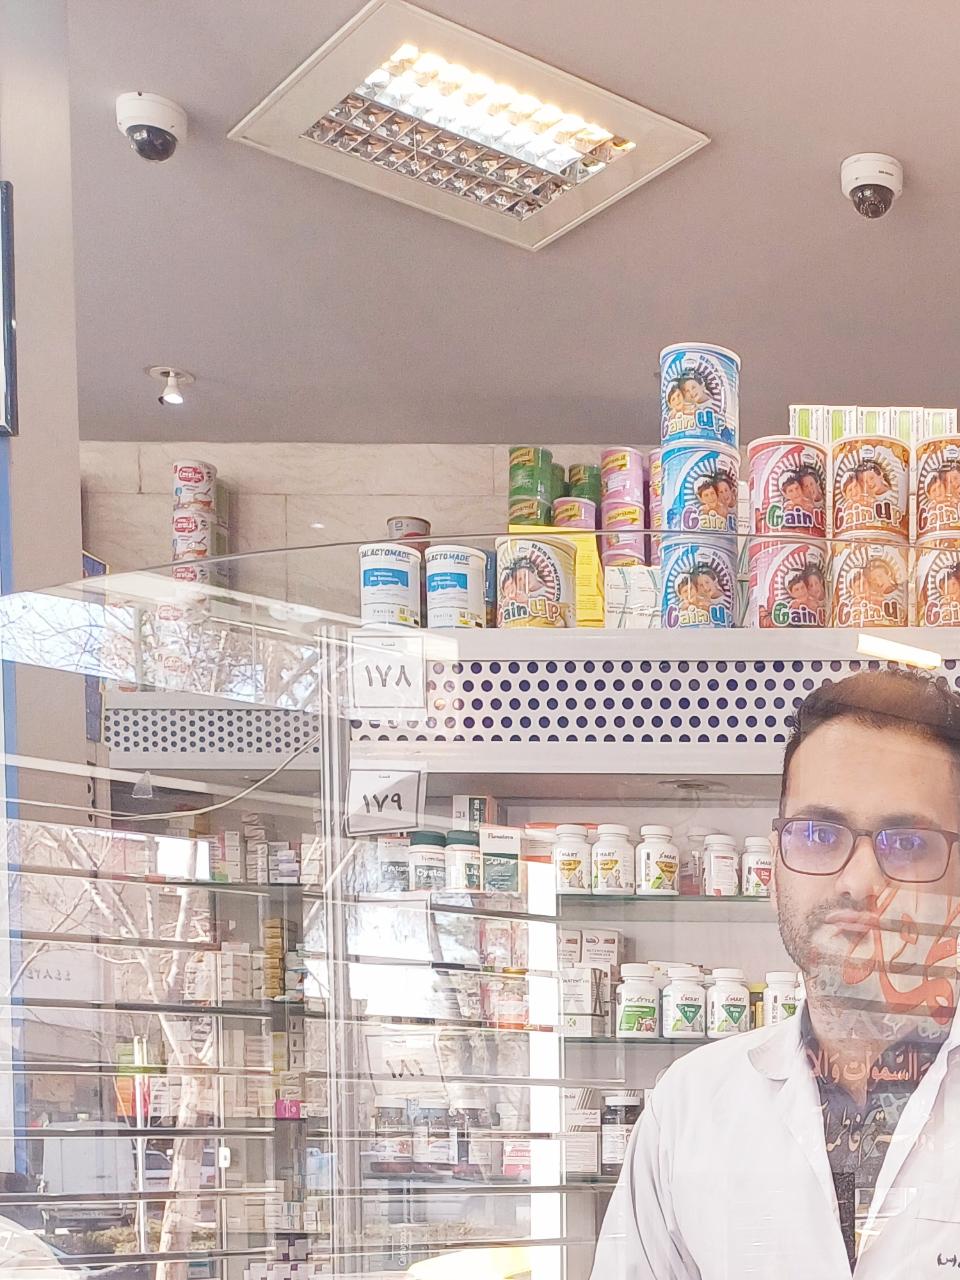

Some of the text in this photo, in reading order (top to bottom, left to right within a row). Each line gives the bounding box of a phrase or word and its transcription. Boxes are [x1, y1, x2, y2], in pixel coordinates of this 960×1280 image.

[766, 503, 814, 529] Gain
[834, 502, 874, 532] Gain
[918, 502, 957, 532] Gain
[666, 605, 710, 629] Gain
[771, 601, 819, 627] Gain
[363, 791, 403, 814] ۱۷۹
